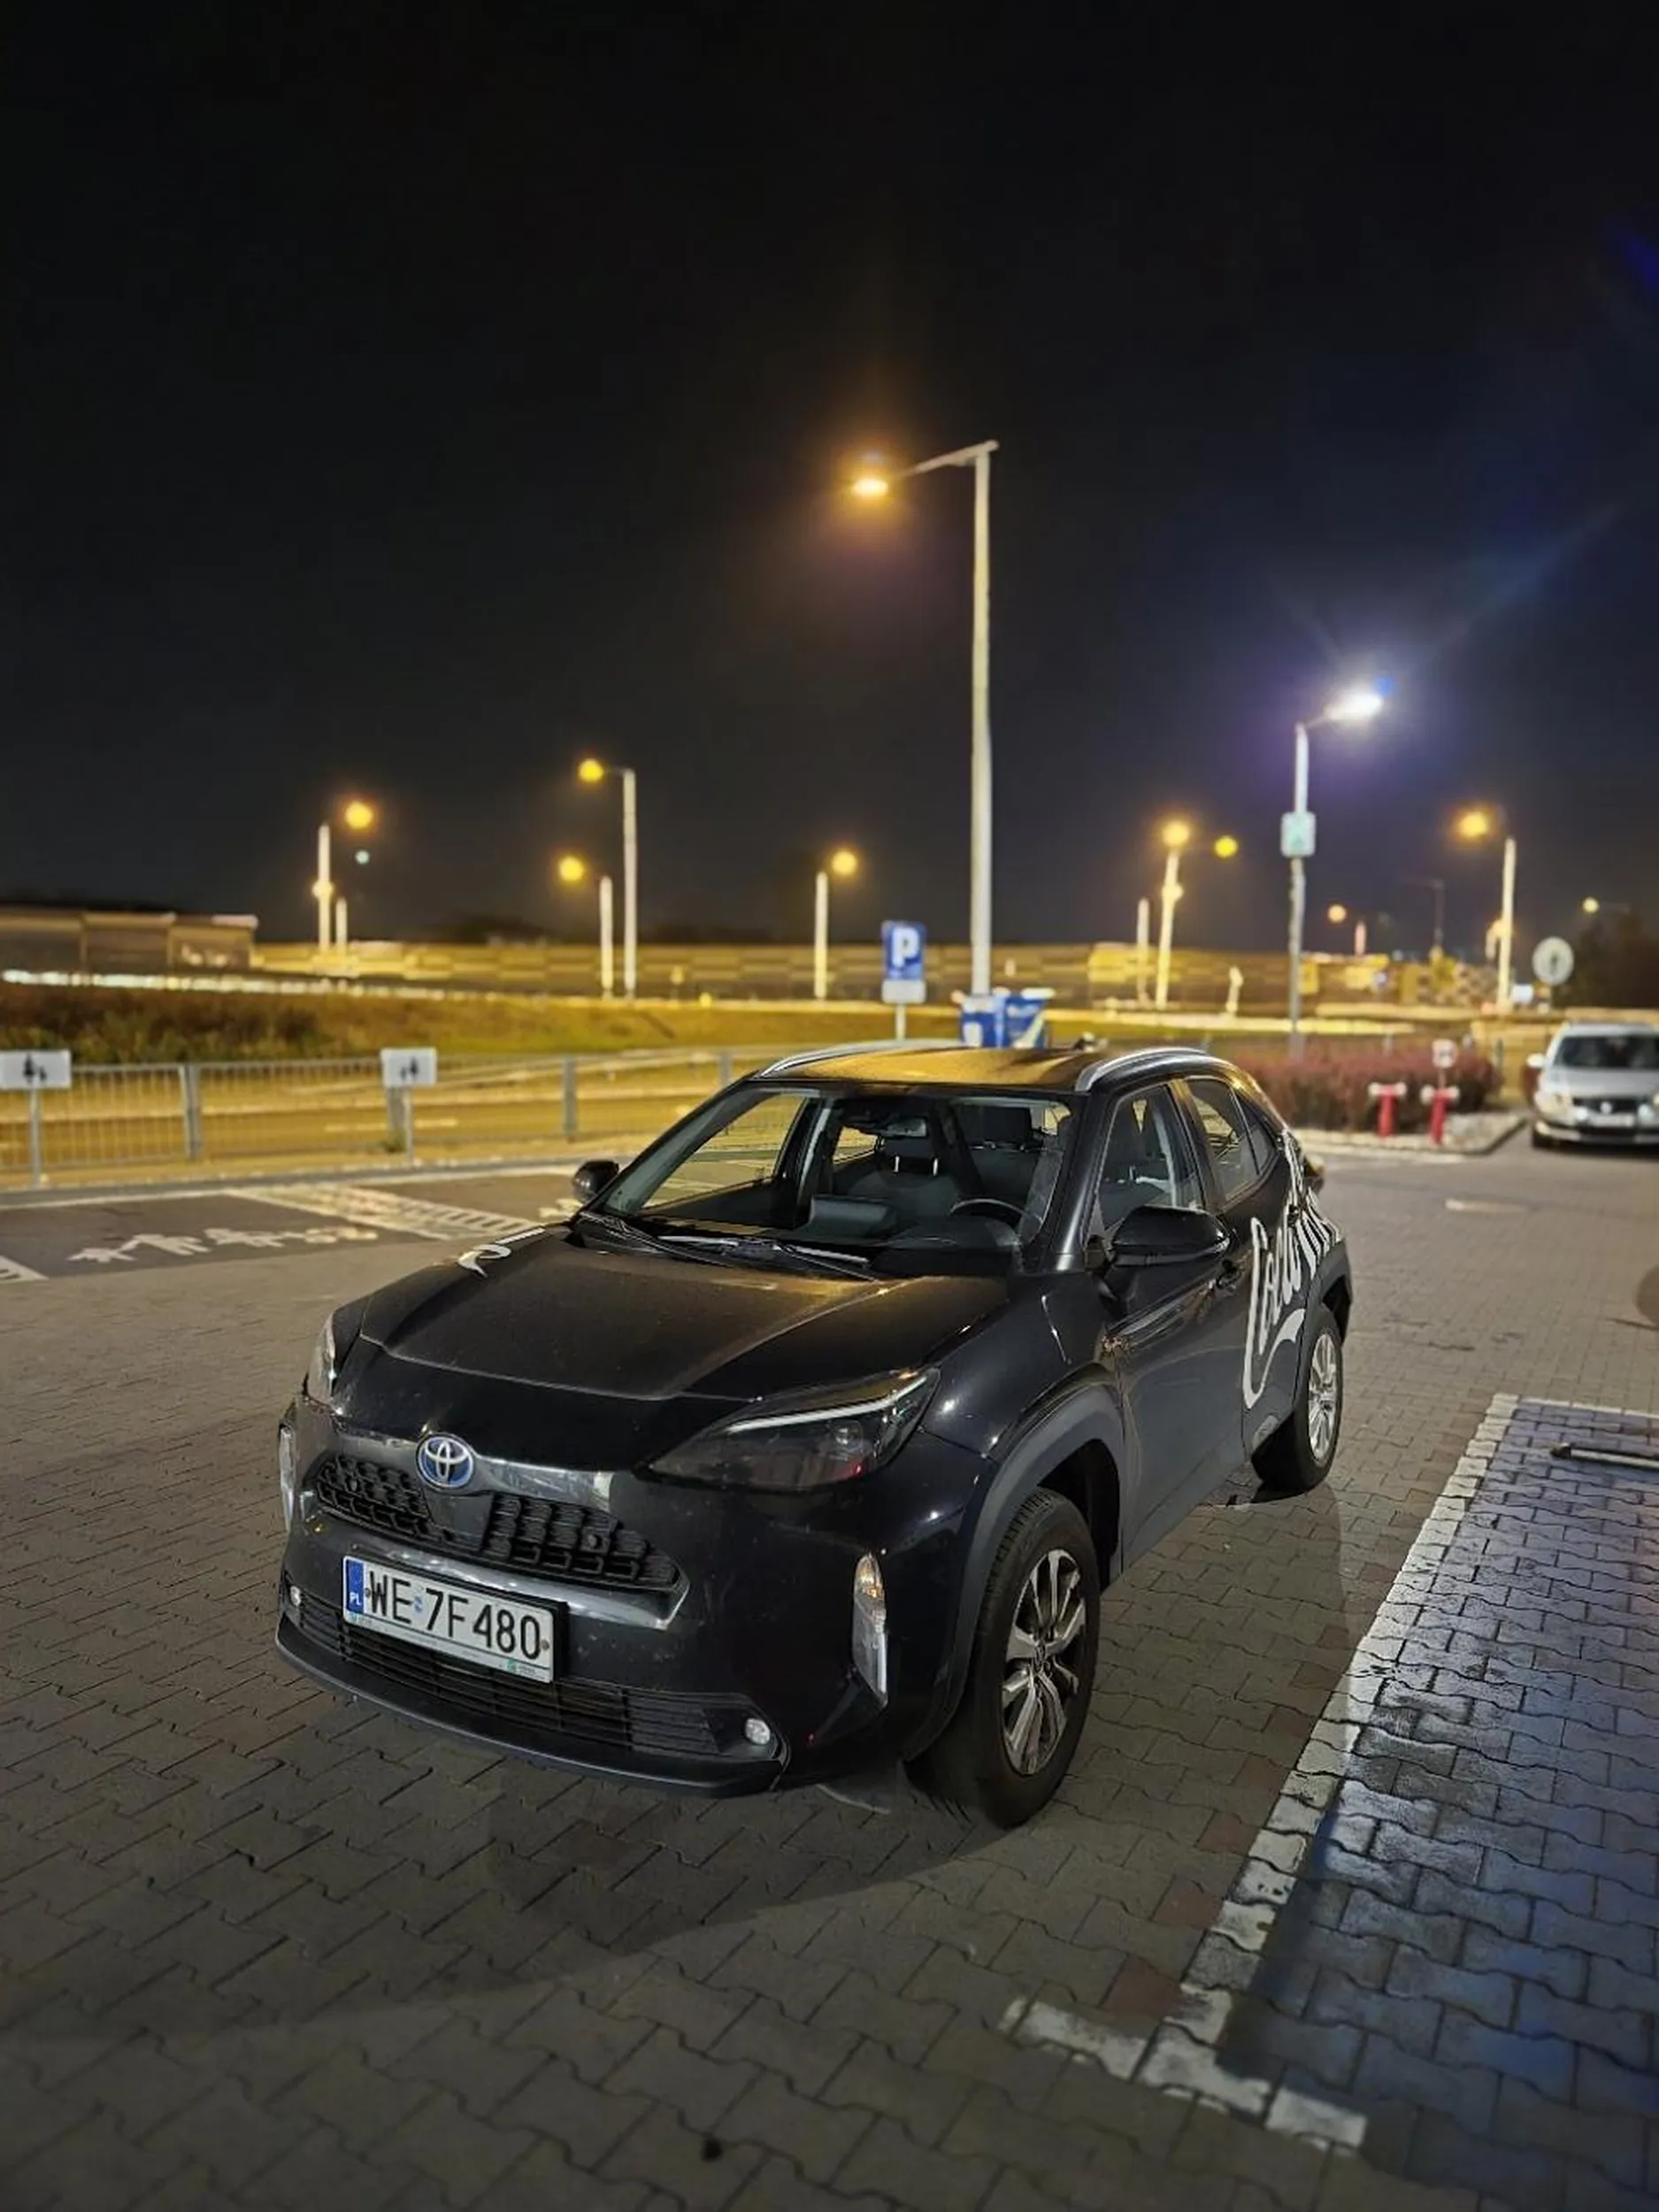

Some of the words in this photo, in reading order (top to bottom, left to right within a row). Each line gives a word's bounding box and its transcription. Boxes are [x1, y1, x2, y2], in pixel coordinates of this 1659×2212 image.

[891, 926, 920, 969] P
[349, 1591, 361, 1606] PL
[368, 1571, 411, 1624] WE
[425, 1586, 541, 1660] 7F480
